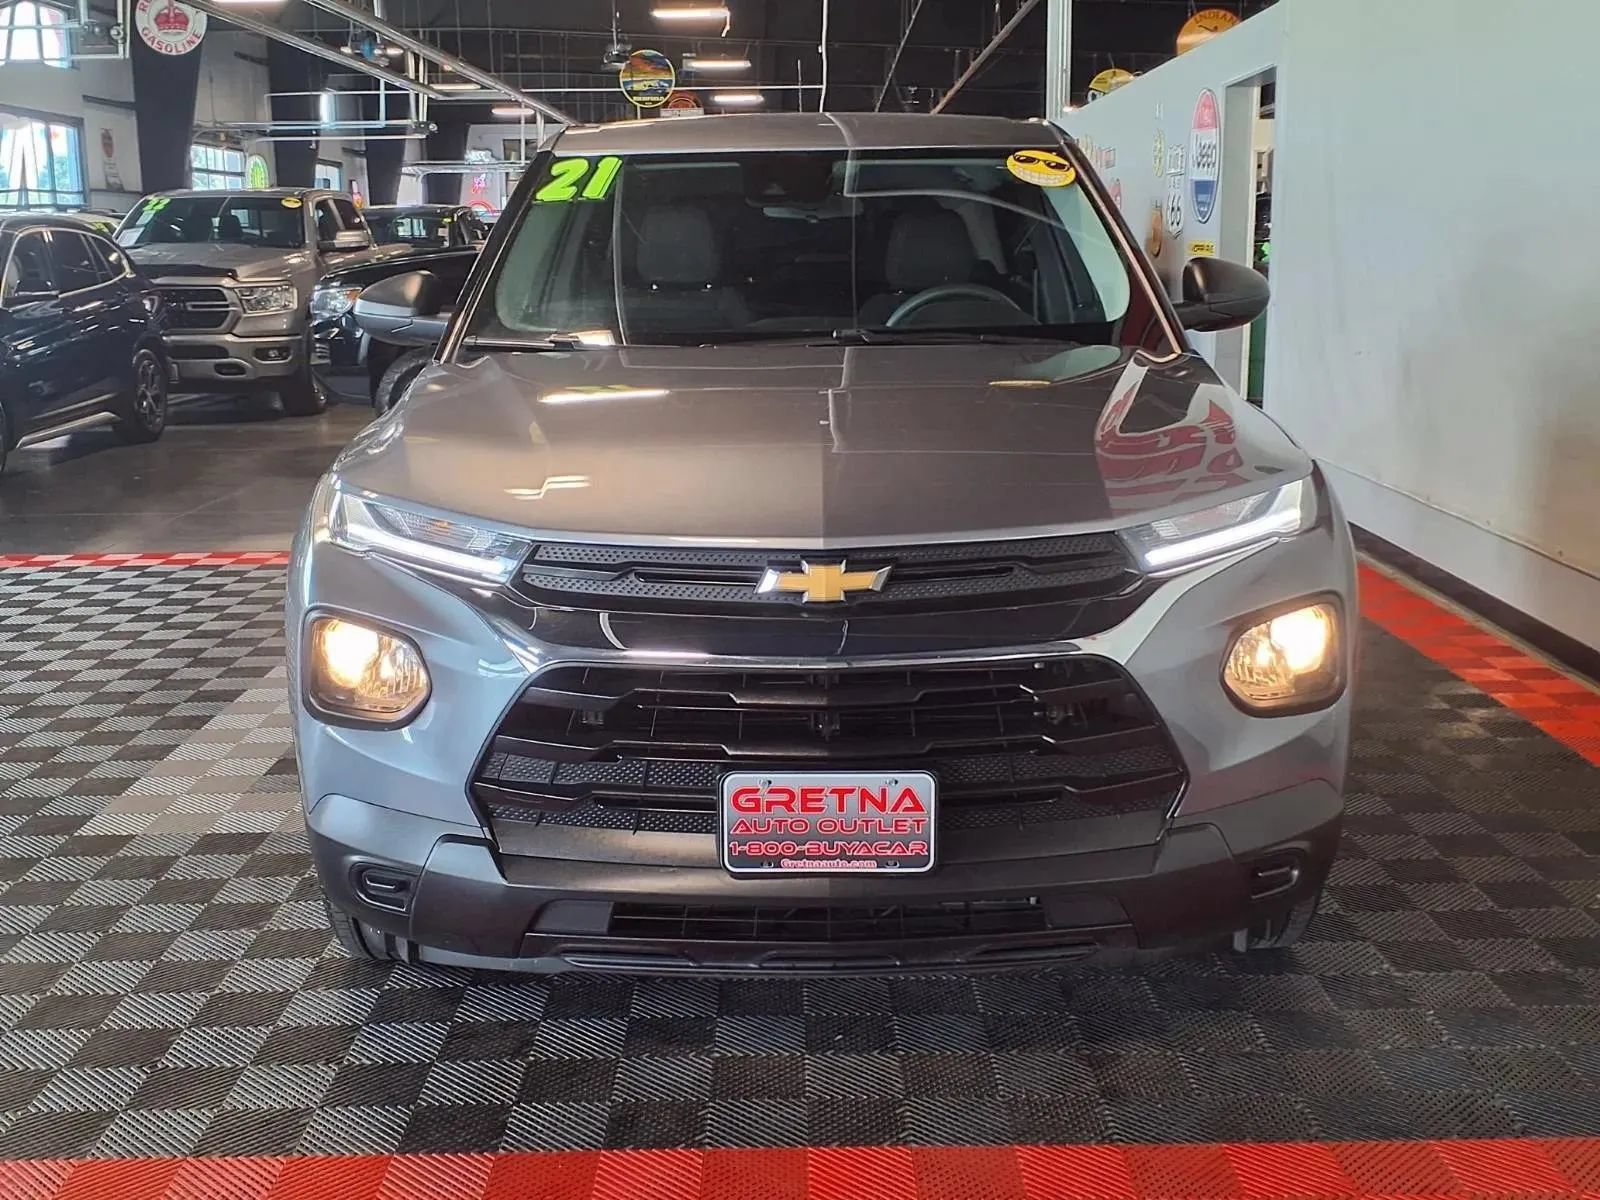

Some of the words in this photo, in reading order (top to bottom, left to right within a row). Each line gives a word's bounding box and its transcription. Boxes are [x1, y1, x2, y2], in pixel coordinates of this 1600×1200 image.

[1193, 10, 1236, 24] INDIAN
[141, 26, 202, 53] GASOLINE
[535, 156, 623, 202] 21
[731, 786, 928, 815] GRETNA
[730, 818, 810, 835] AUTO
[816, 818, 929, 835] OUTLET
[729, 840, 929, 857] 1-800-BUYACAR
[780, 858, 878, 870] Gretnaauto.com
